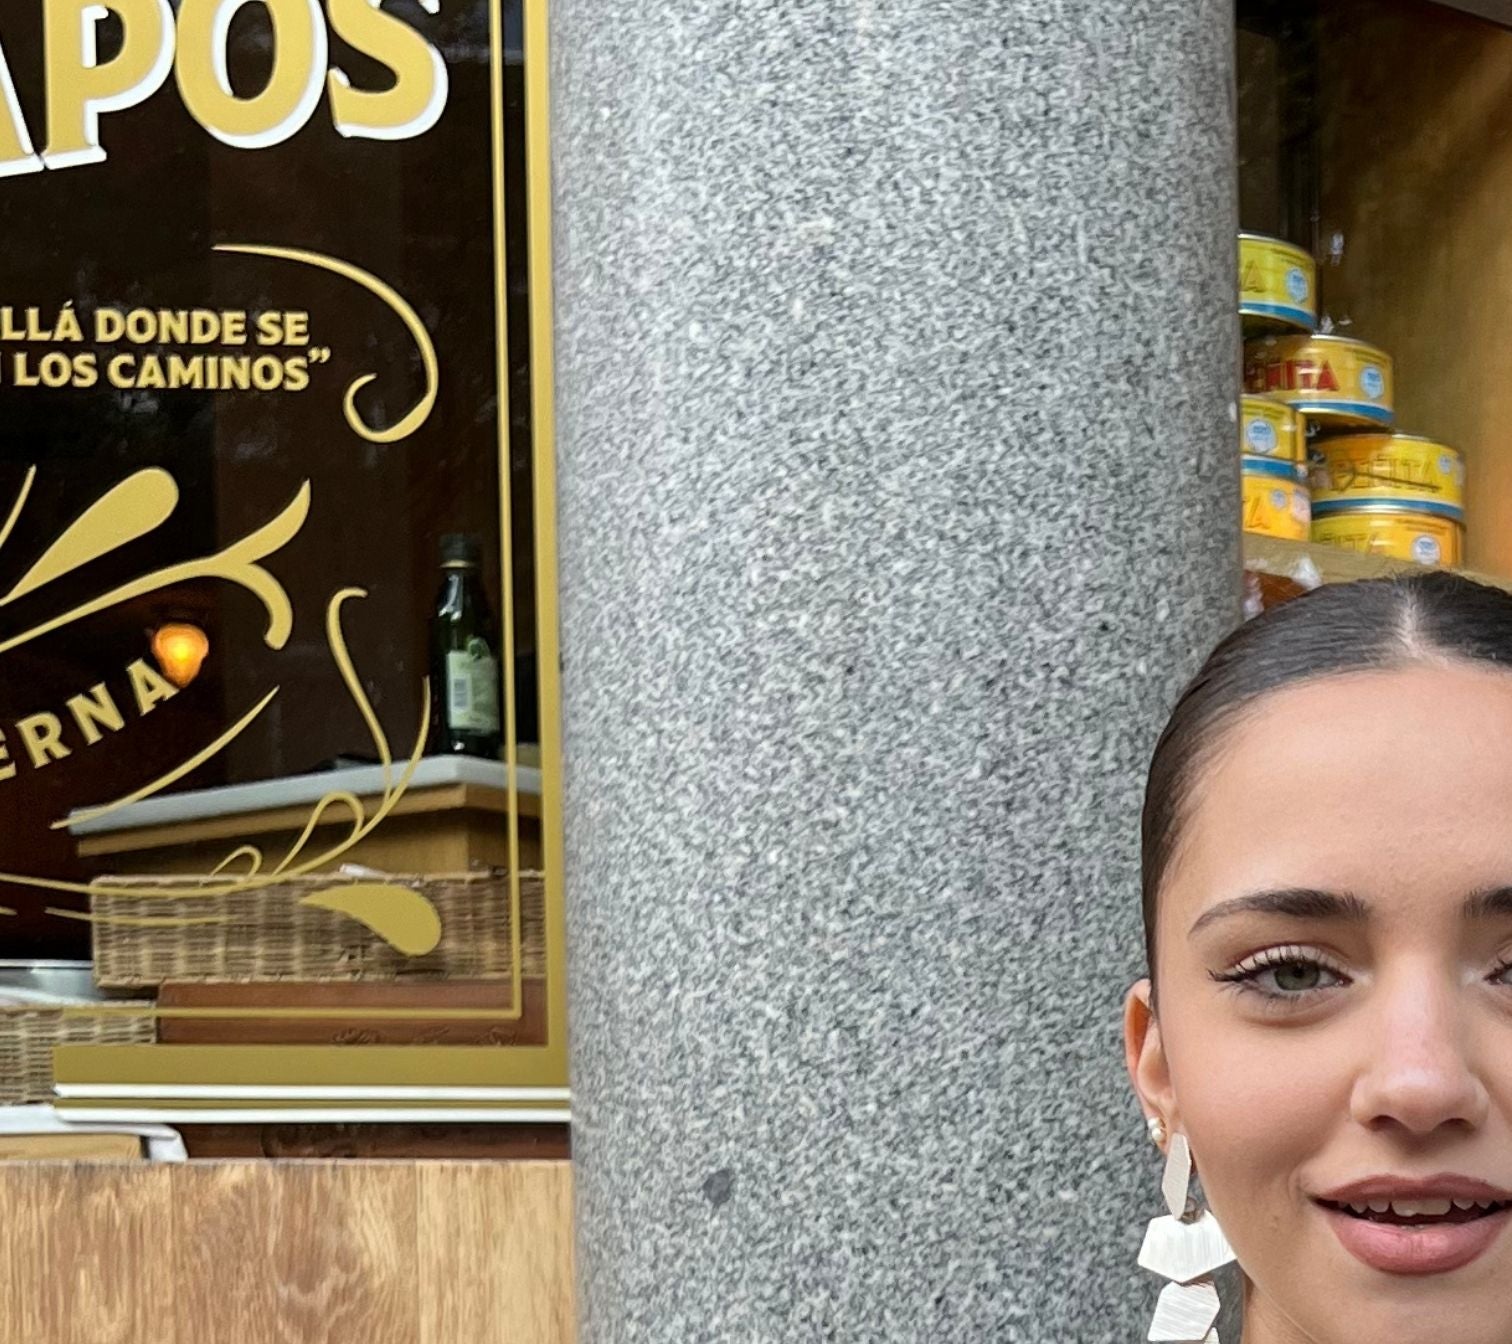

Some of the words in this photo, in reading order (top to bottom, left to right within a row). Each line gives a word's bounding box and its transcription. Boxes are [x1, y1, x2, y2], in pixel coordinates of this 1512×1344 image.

[94, 307, 247, 345] DONDE
[257, 310, 310, 346] SE
[13, 351, 98, 388] LOS
